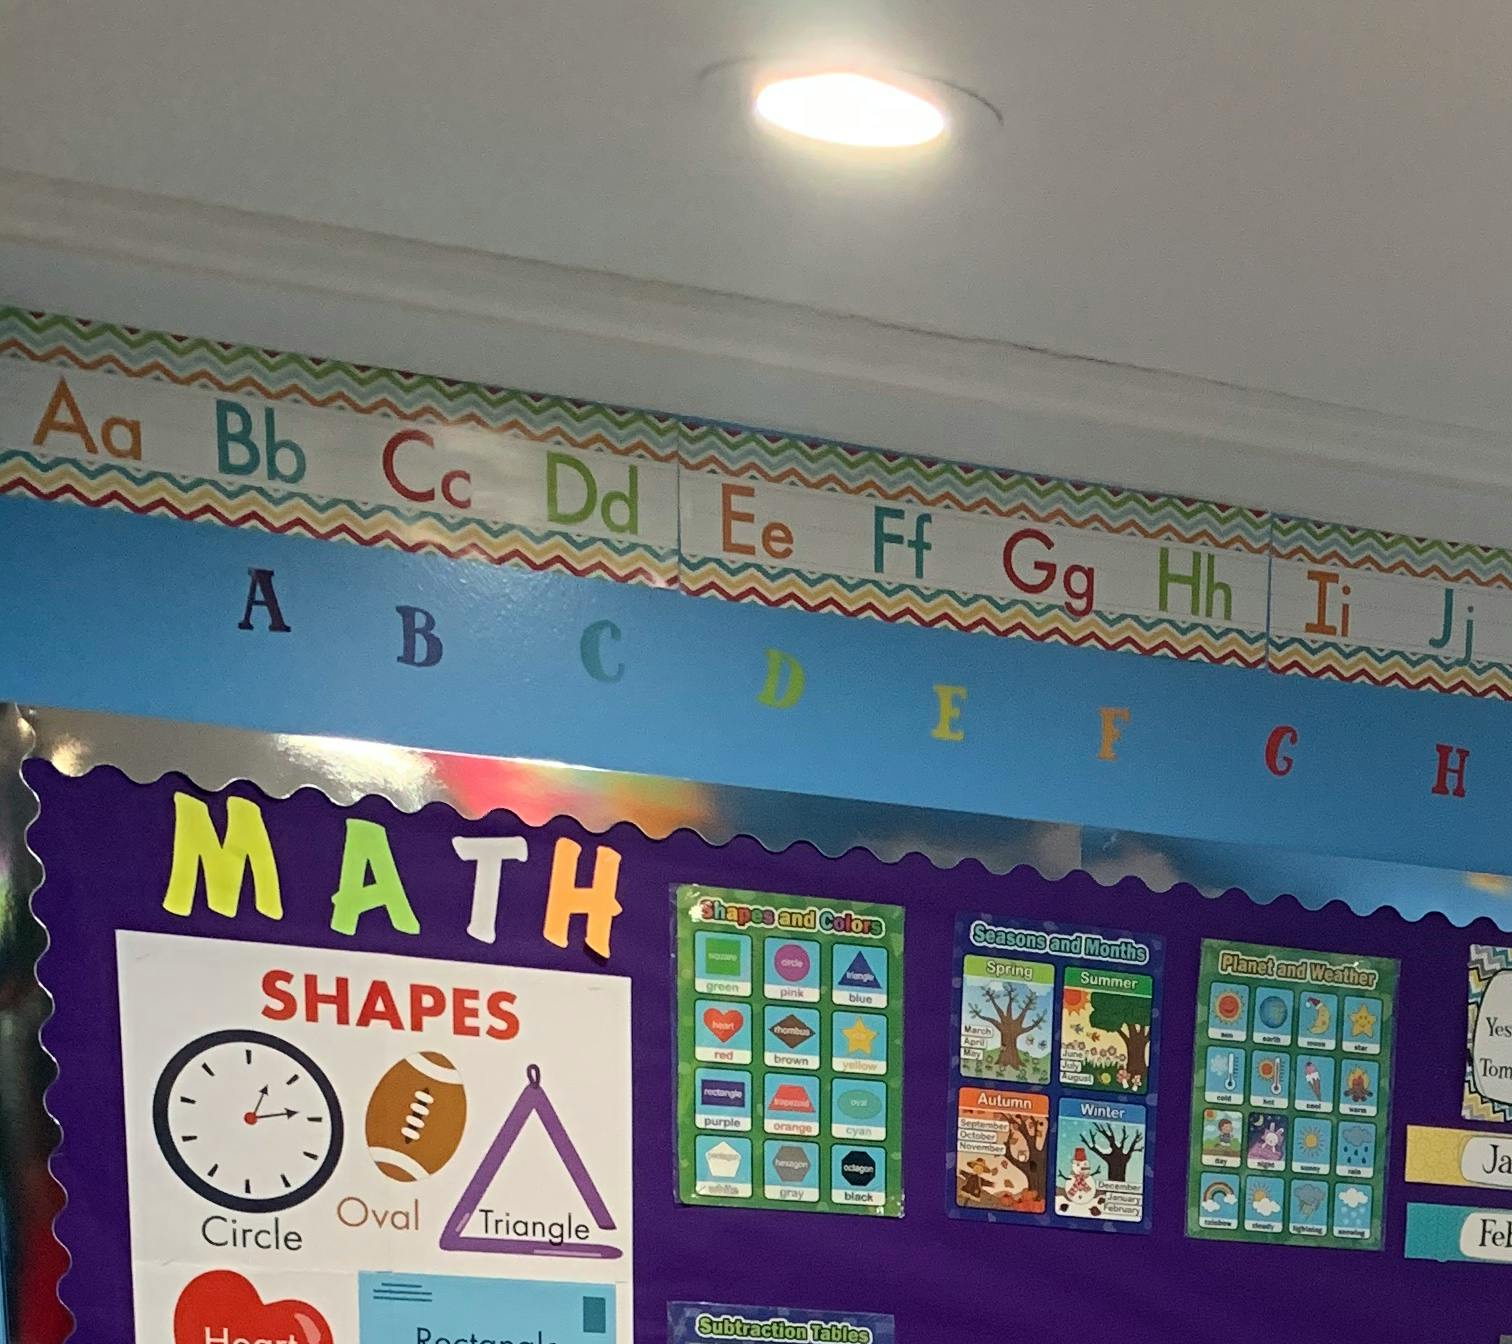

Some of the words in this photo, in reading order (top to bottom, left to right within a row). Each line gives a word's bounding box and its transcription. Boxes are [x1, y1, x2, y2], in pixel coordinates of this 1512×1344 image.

[34, 377, 142, 461] Aa
[217, 400, 306, 485] Bb
[723, 484, 794, 560] Ee
[1003, 528, 1095, 616] Gg
[239, 568, 290, 632] A
[396, 605, 443, 667] B
[932, 685, 967, 742] E
[1432, 744, 1469, 798] H
[163, 792, 623, 958] MATH
[701, 900, 774, 926] Shapes
[778, 909, 816, 929] and
[819, 910, 884, 936] Colors
[973, 924, 1046, 949] Seasons
[1050, 937, 1082, 954] and
[1085, 938, 1147, 962] Months
[986, 961, 1033, 980] Spring
[1221, 954, 1274, 975] Planet
[1277, 962, 1307, 978] and
[1310, 964, 1377, 987] Weather
[706, 982, 739, 993] green
[1080, 971, 1138, 990] Summer
[780, 988, 804, 1000] pink
[849, 993, 873, 1004] blue
[261, 970, 520, 1040] SHAPES
[964, 1026, 991, 1035] March
[714, 1049, 734, 1061] red
[774, 1055, 808, 1066] brown
[842, 1061, 877, 1071] yellow
[977, 1092, 1032, 1109] Autumn
[1080, 1103, 1126, 1119] Winter
[704, 1118, 741, 1128] purple
[774, 1123, 812, 1134] orange
[846, 1127, 871, 1137] cyan
[780, 1189, 804, 1199] gray
[844, 1192, 873, 1202] black
[337, 1196, 419, 1232] Oval
[201, 1215, 302, 1252] Circle
[478, 1209, 590, 1246] Triangle
[698, 1316, 808, 1340] Subtraction
[810, 1324, 870, 1344] Tables
